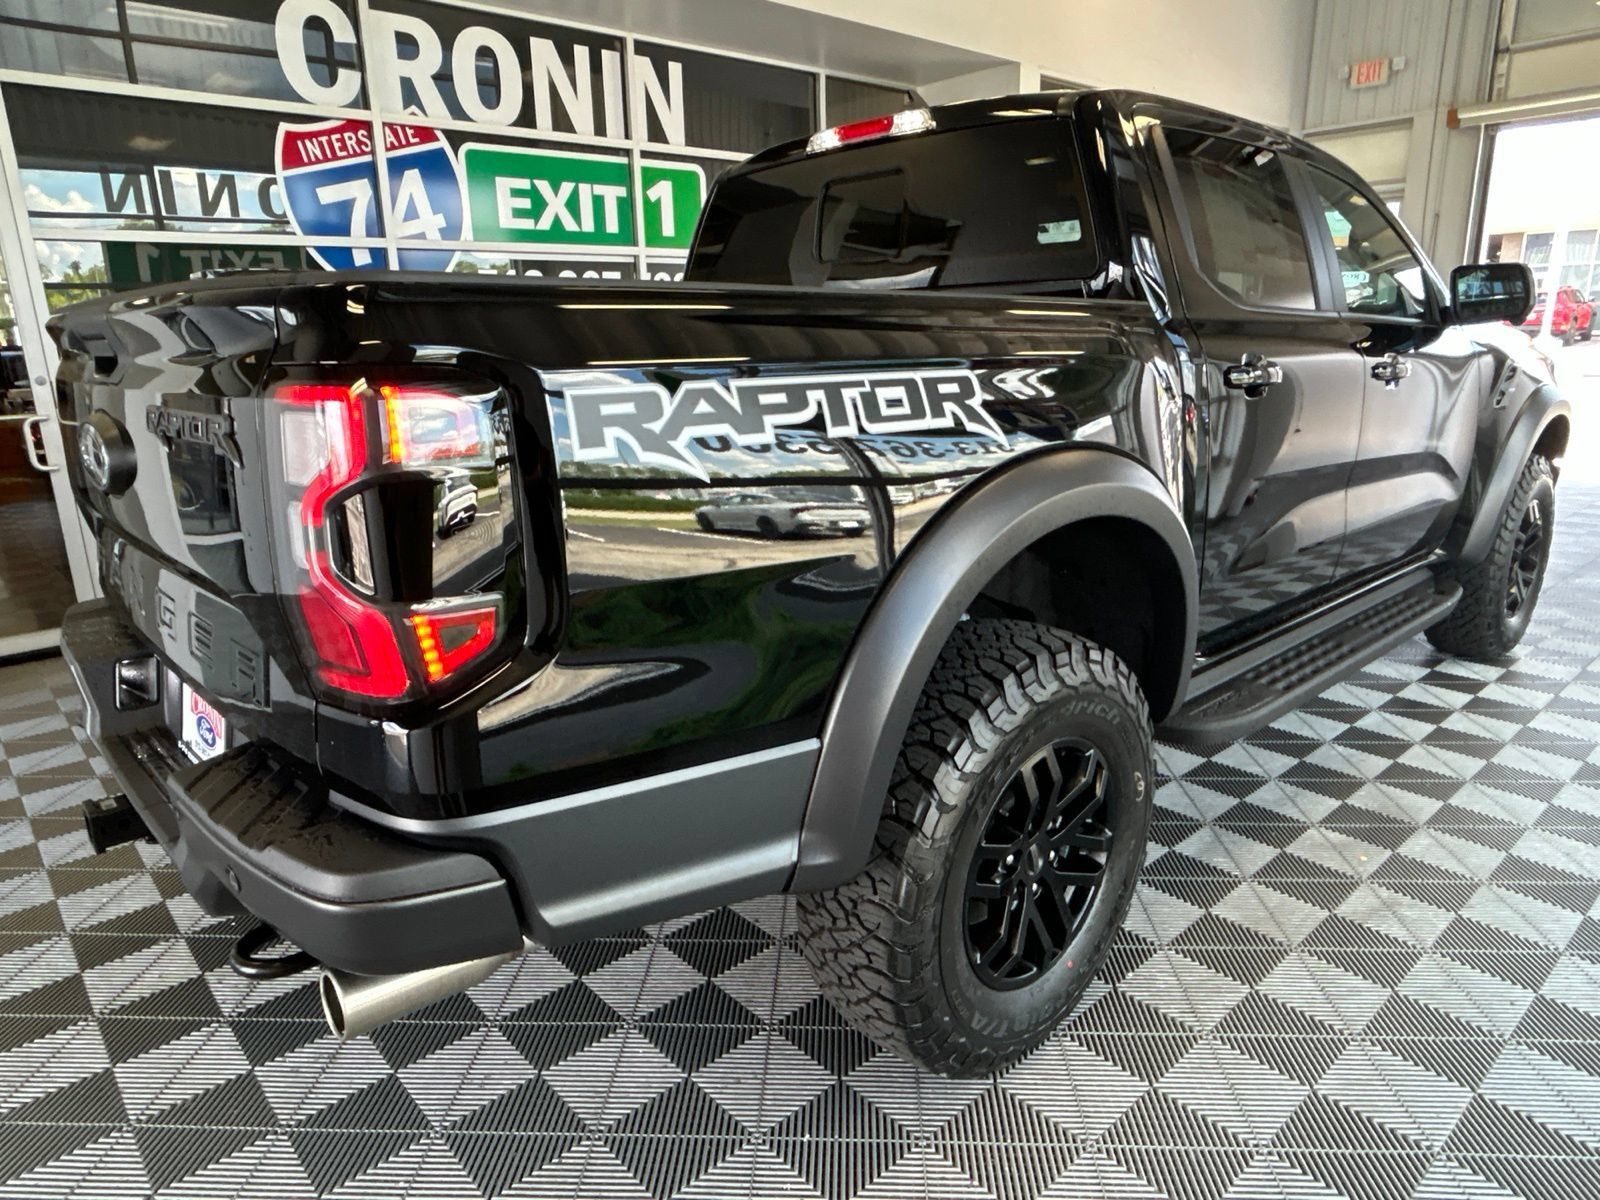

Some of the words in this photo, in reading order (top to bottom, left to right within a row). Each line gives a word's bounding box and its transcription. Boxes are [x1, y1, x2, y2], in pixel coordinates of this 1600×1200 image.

[275, 0, 686, 147] CRONIN
[1355, 59, 1384, 85] EXIT
[296, 125, 420, 164] INTERSATE
[316, 168, 447, 267] 74
[495, 176, 627, 235] EXIT
[646, 180, 675, 238] 1
[146, 404, 245, 469] RAPTOR
[563, 369, 1010, 483] RAPTOR
